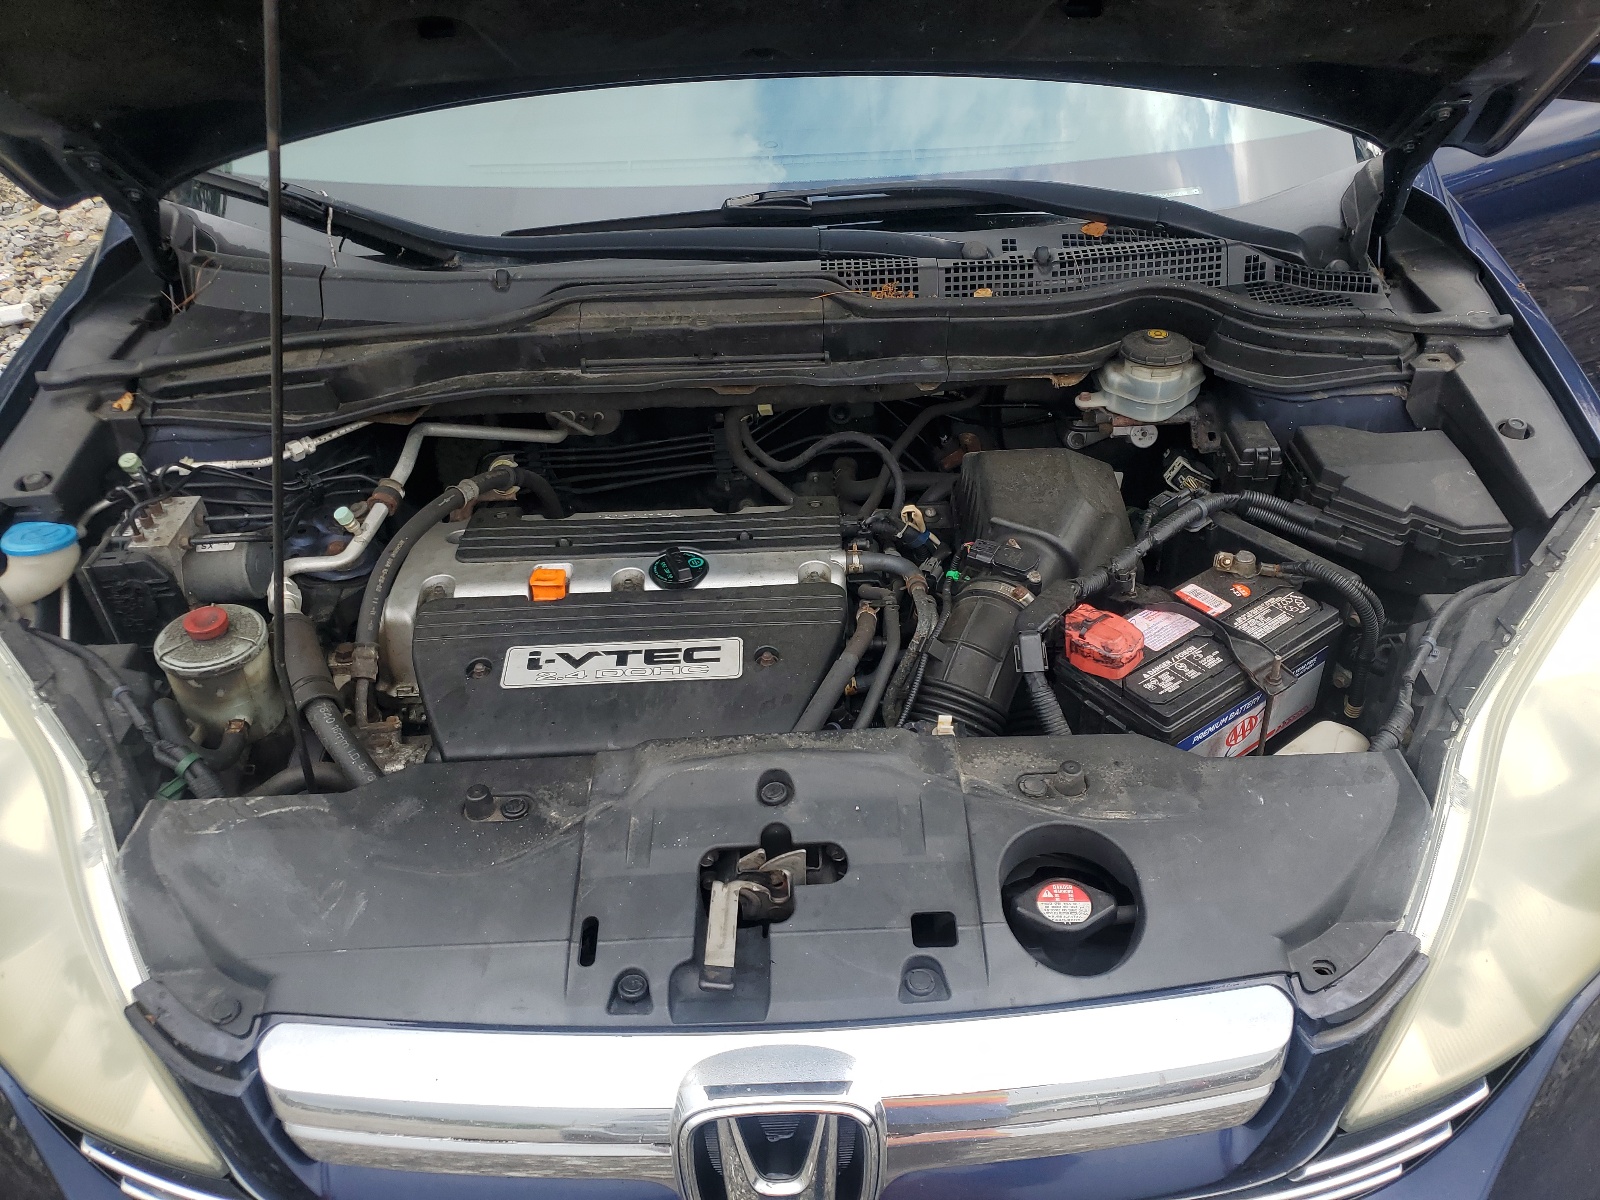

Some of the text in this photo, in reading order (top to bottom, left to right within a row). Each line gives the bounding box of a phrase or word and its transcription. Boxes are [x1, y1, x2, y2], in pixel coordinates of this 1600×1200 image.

[526, 645, 722, 671] i-VTEC
[535, 664, 710, 682] 2.4 DOHC
[1147, 659, 1172, 676] DANGER
[1175, 645, 1198, 660] POISON
[1191, 715, 1229, 745] PREMIUM
[1227, 693, 1263, 721] BATTERY
[1226, 716, 1257, 746] AAA
